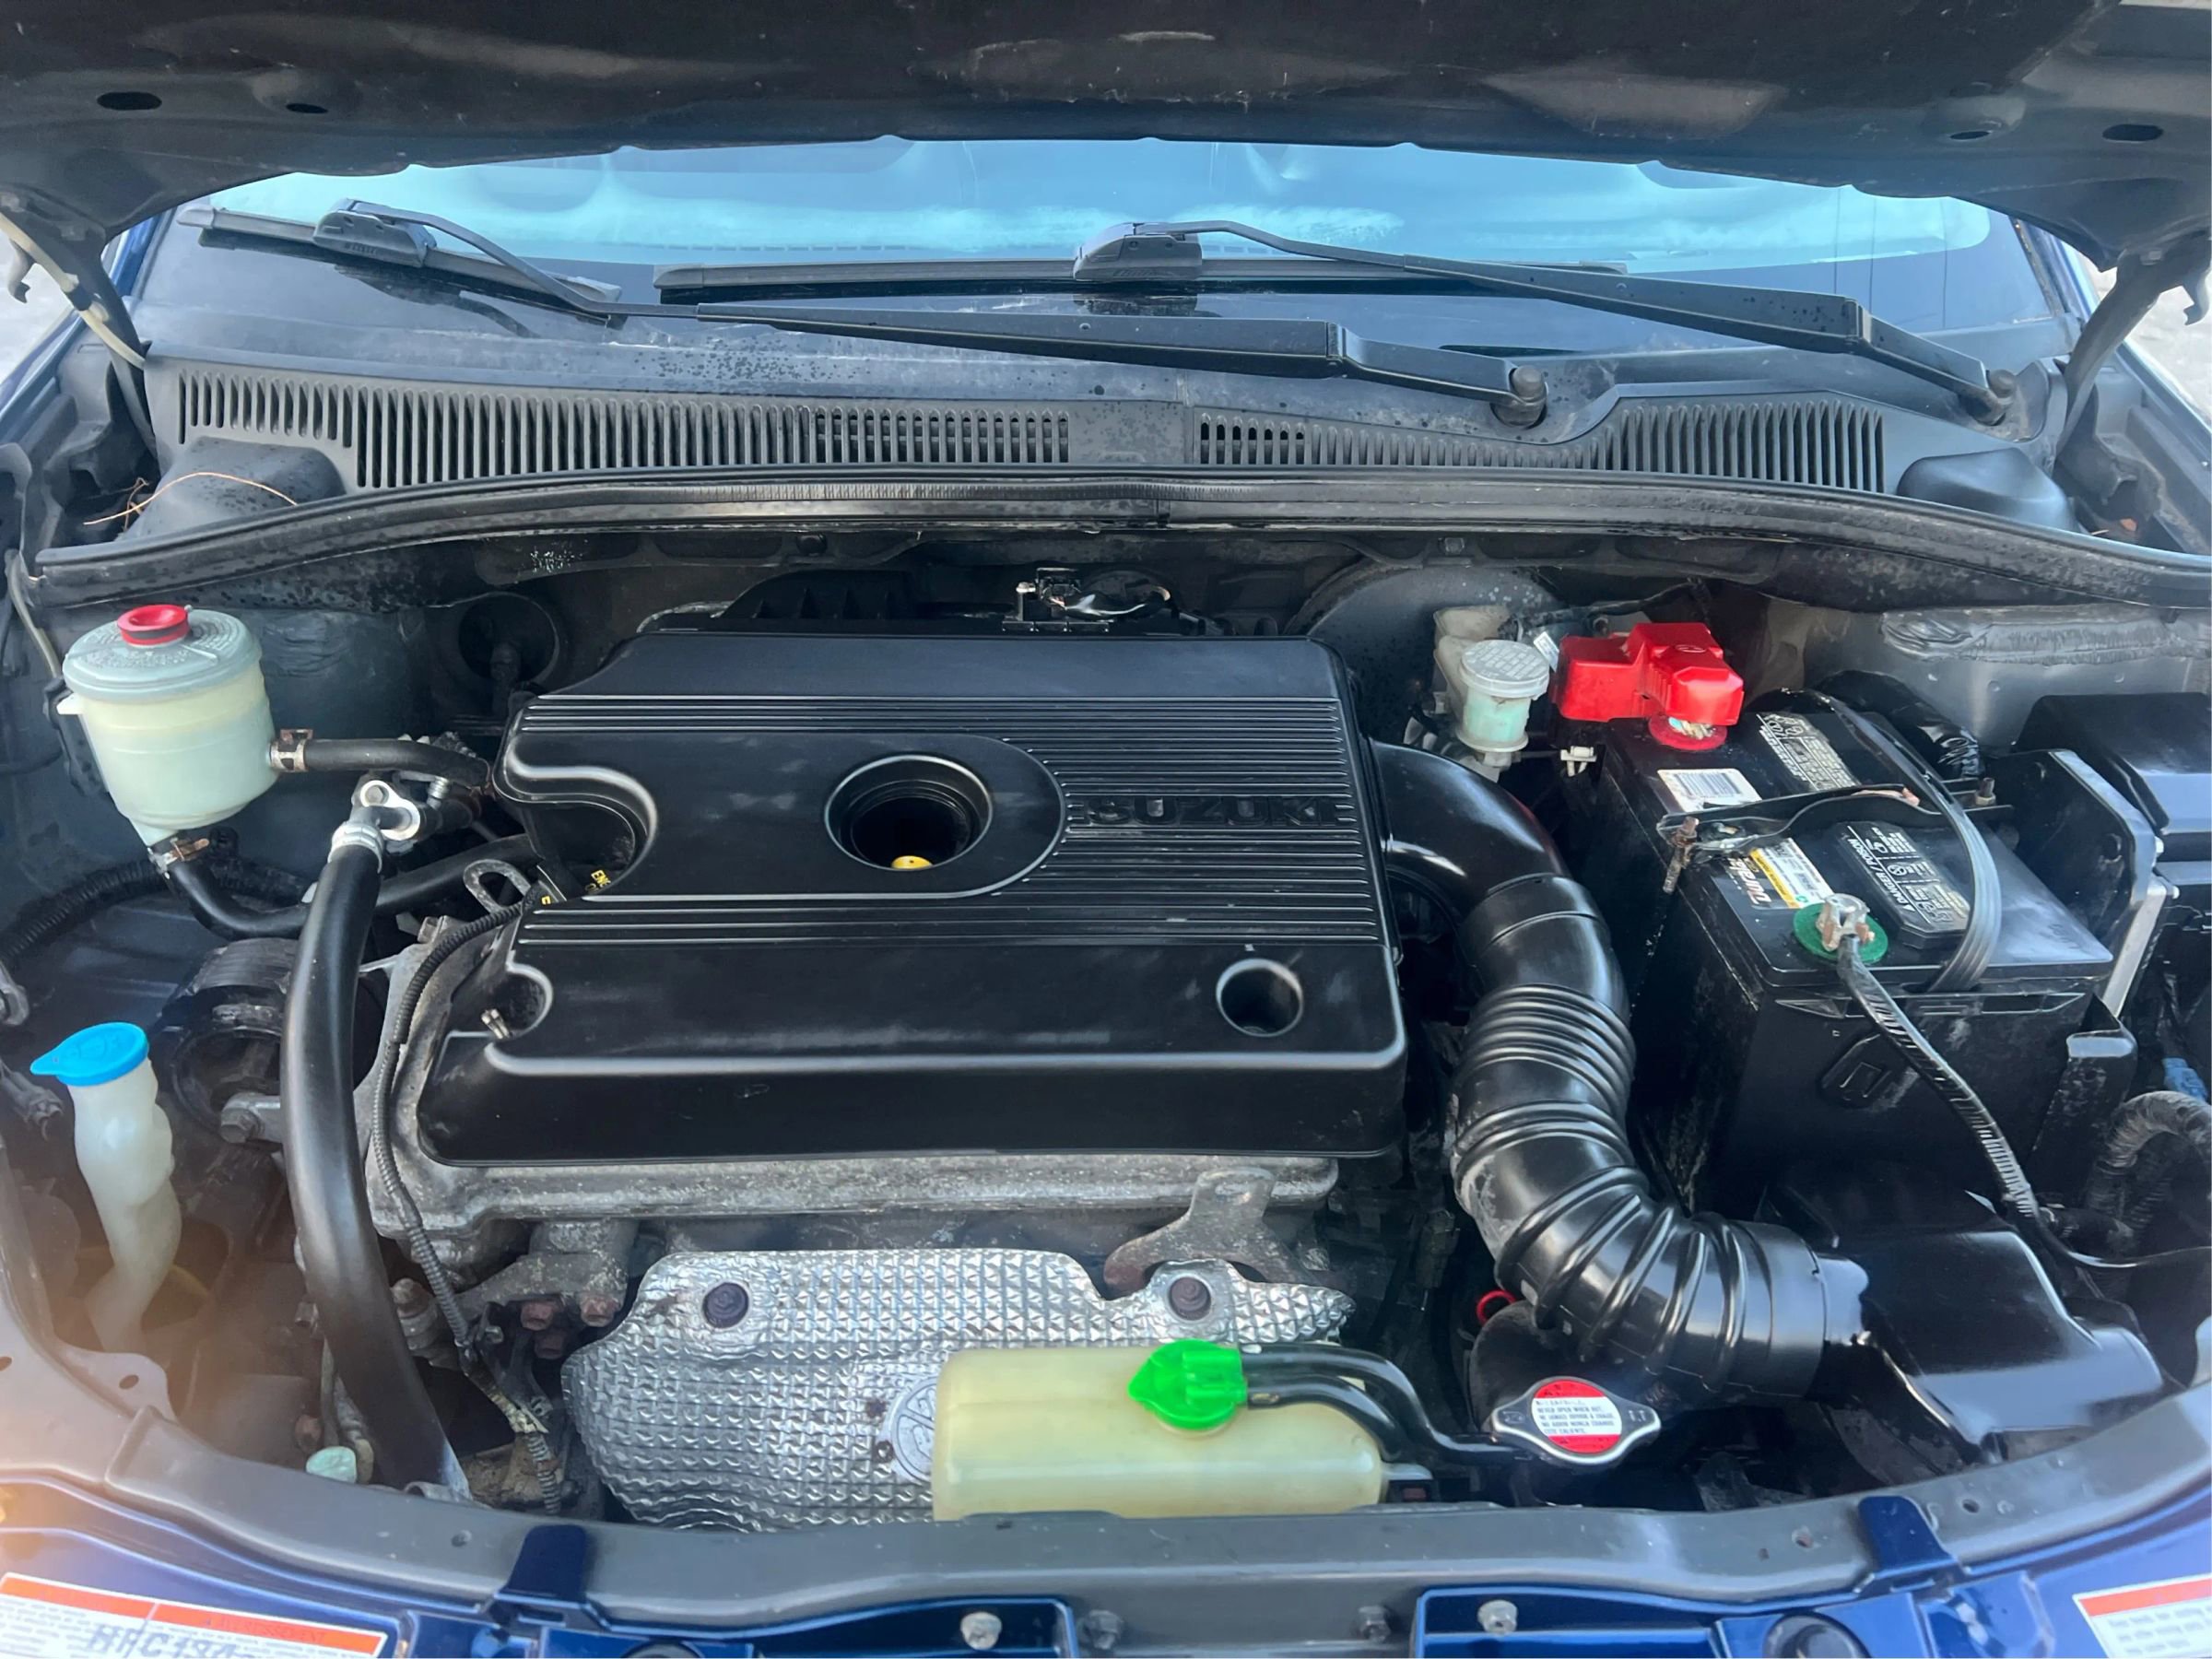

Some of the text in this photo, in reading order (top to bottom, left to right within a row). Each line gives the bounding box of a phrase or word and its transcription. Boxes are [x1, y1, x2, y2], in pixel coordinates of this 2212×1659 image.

[1087, 795, 1336, 827] SUZUKI
[1847, 839, 1877, 865] POISON
[1875, 872, 1909, 904] DANGER
